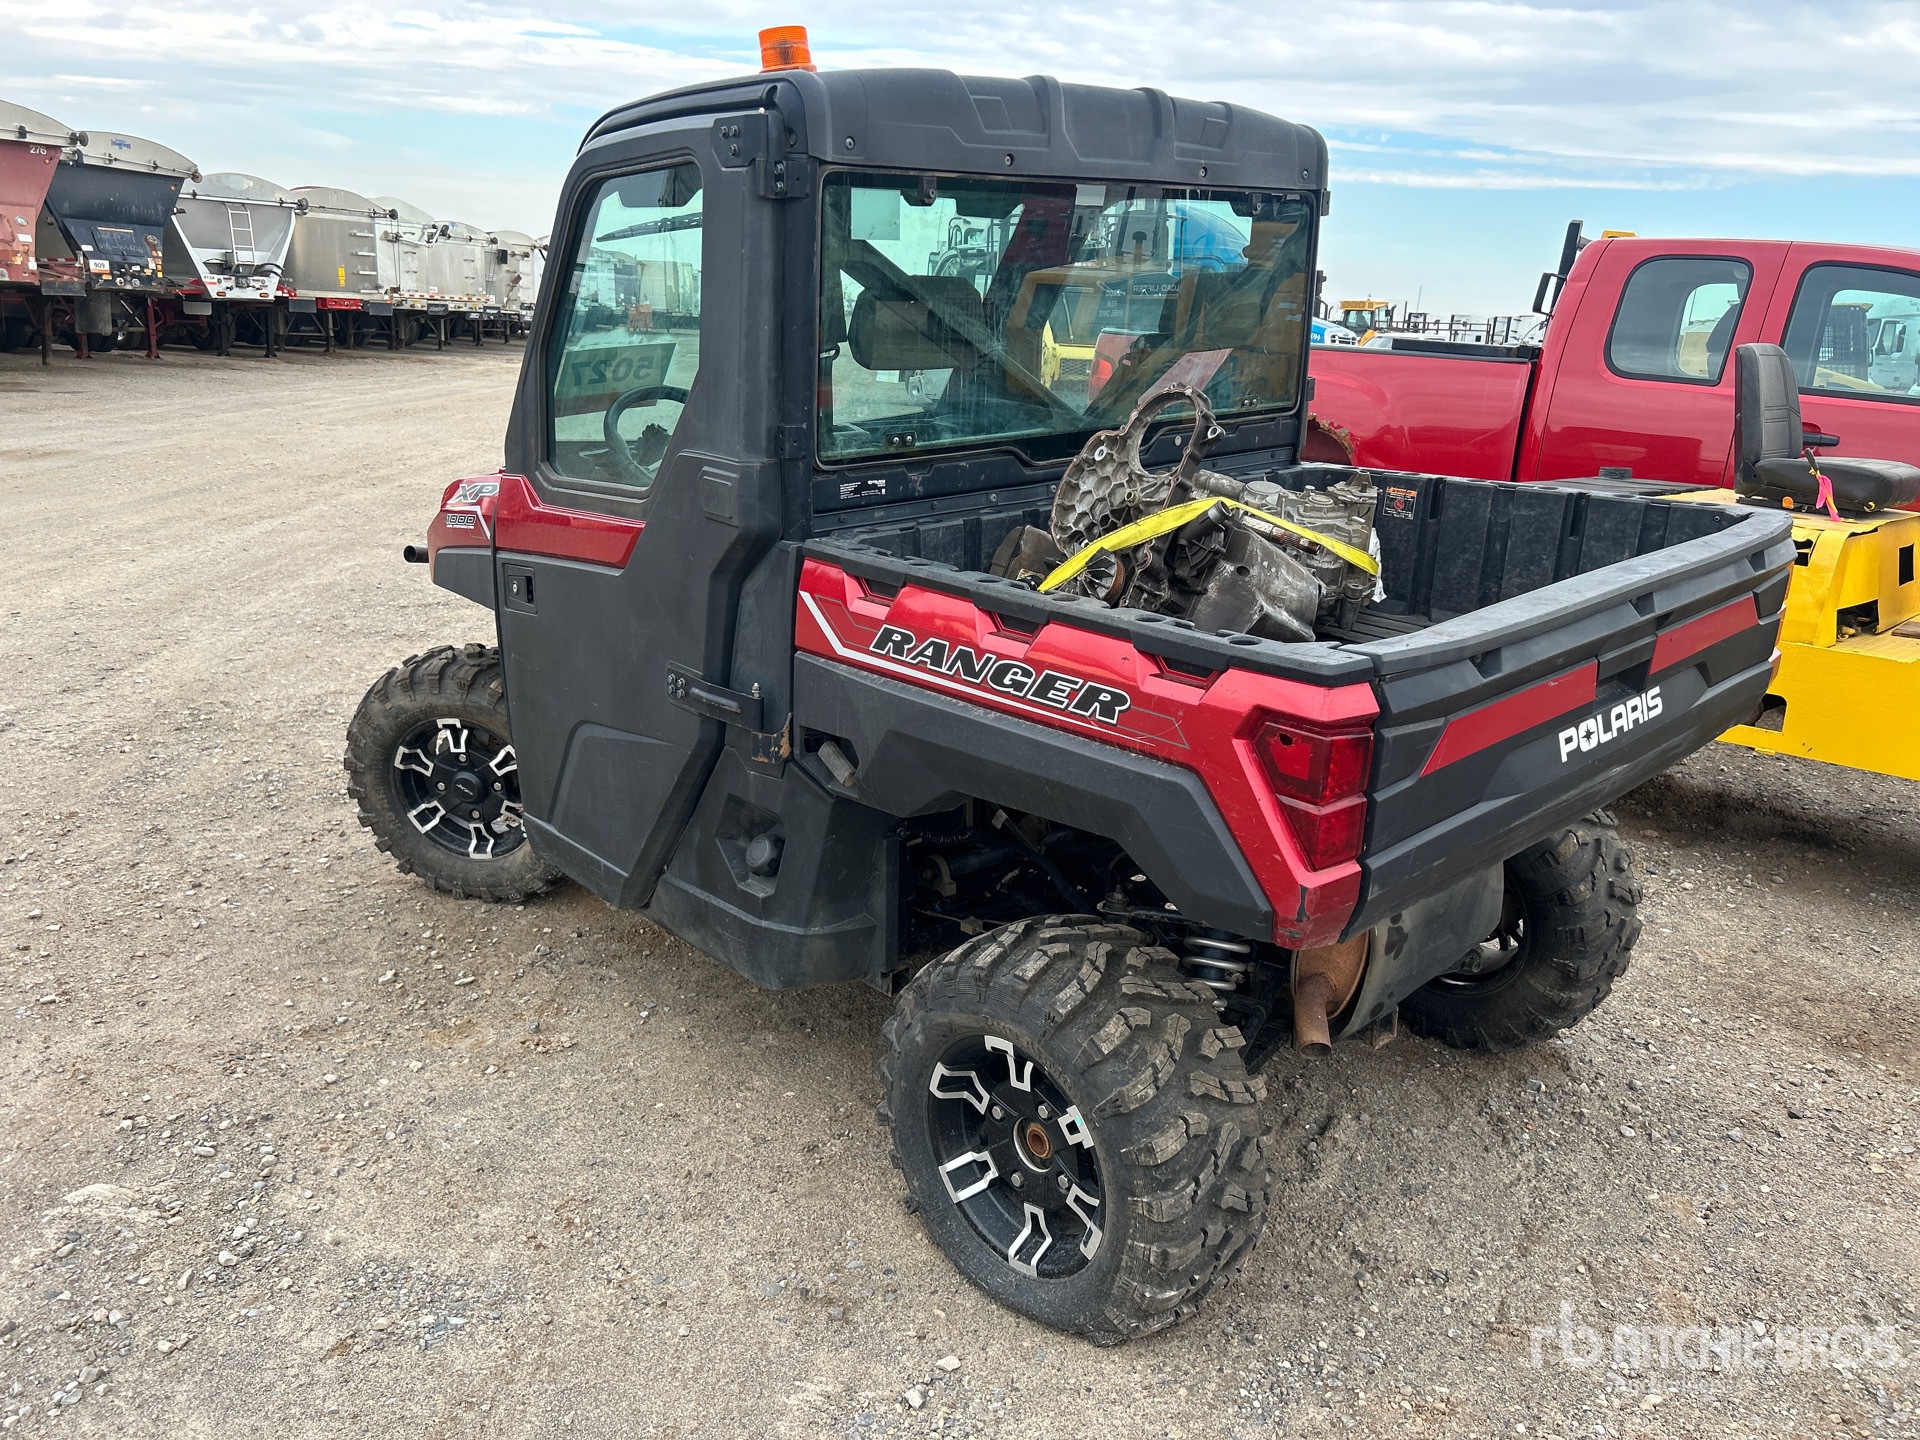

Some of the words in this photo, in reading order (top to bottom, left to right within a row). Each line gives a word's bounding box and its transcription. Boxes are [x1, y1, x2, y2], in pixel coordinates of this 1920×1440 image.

[29, 145, 47, 155] 276
[447, 483, 499, 503] XP
[446, 514, 476, 526] 1000
[868, 624, 1131, 725] RANGER
[1558, 685, 1663, 763] POLARIS
